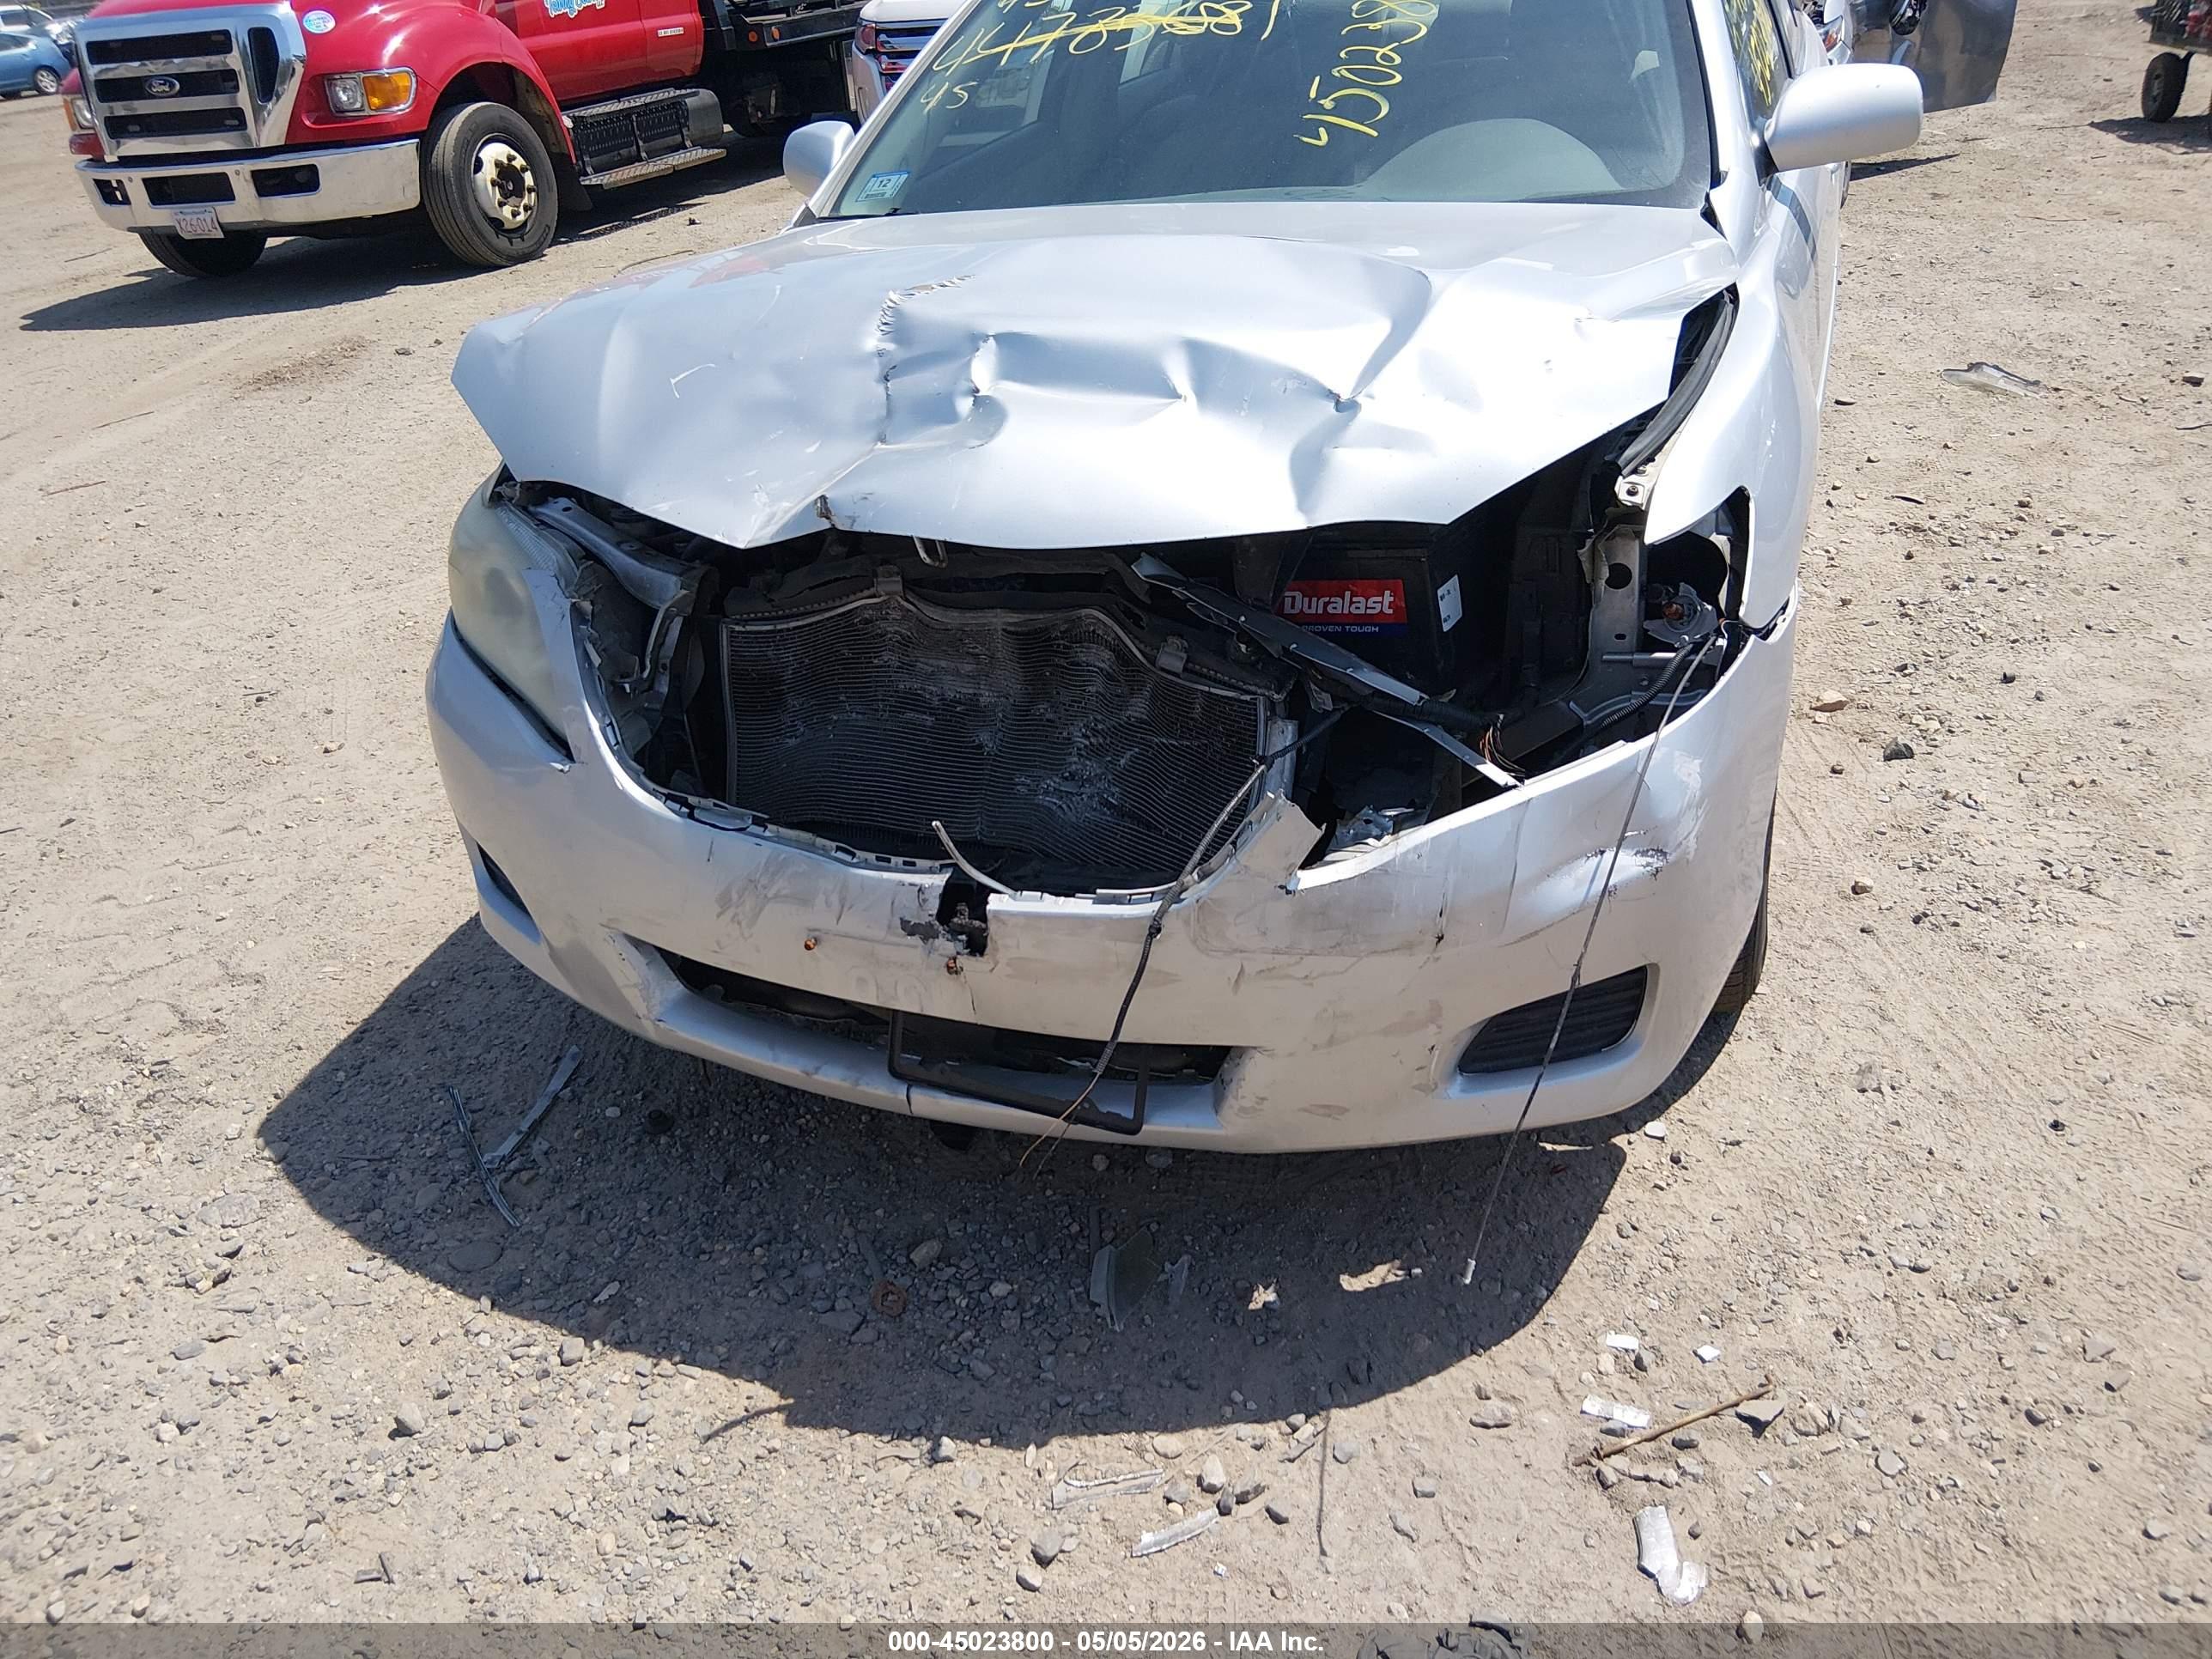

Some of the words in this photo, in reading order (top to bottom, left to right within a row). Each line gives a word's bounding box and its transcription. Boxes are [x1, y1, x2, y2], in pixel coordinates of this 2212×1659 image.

[151, 79, 171, 93] Ford
[920, 82, 979, 114] 45
[878, 179, 891, 188] 12
[1284, 590, 1395, 614] Duralast
